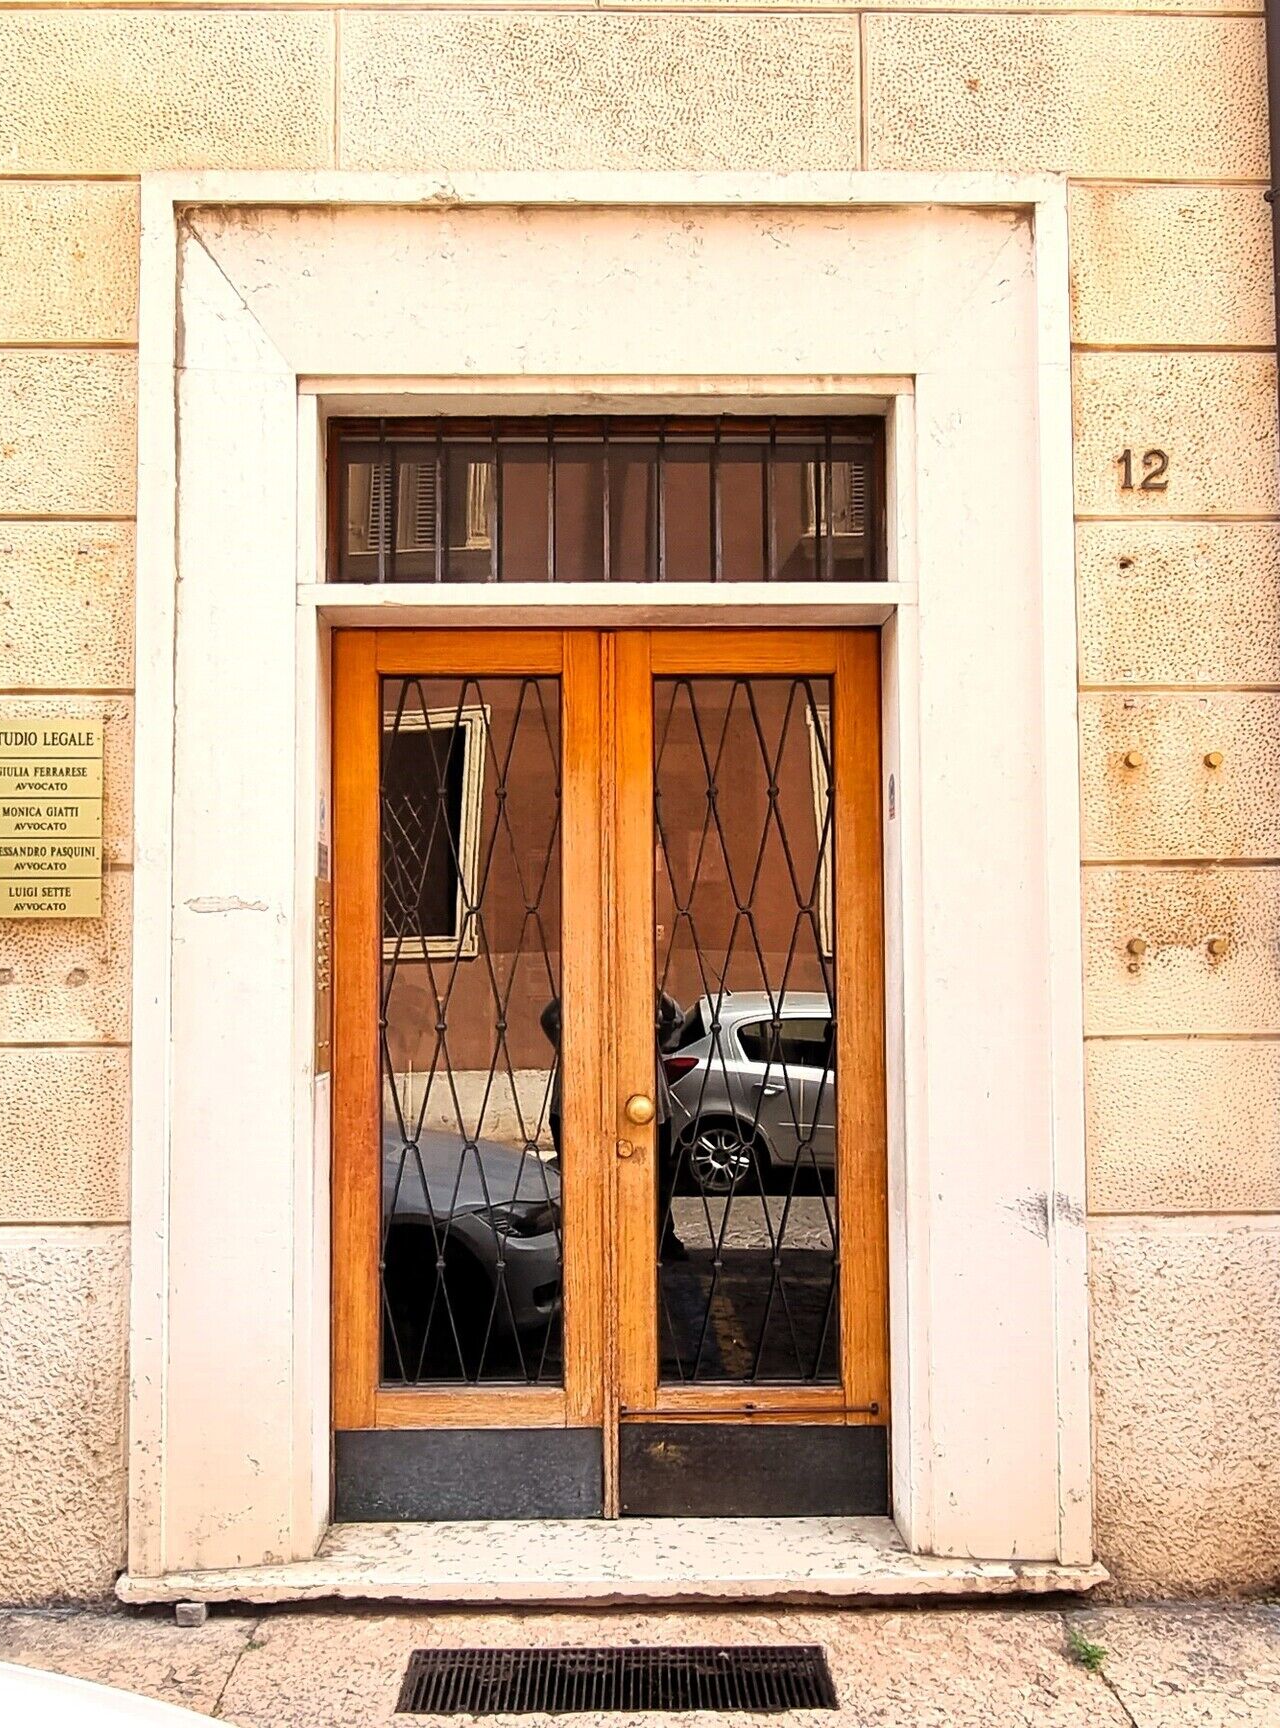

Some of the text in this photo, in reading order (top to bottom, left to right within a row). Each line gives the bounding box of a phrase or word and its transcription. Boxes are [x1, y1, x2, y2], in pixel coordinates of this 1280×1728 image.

[1116, 448, 1169, 490] 12
[43, 732, 95, 747] LEGALE
[33, 767, 88, 778] FERRARESE
[15, 782, 68, 792] AVVOCATO
[2, 806, 79, 817] MONICA GIATTI
[14, 822, 67, 831] AVVOCATO
[50, 846, 96, 859] PASQUINI
[14, 862, 67, 871] AVVOCATO
[8, 887, 72, 898] LUIGI SETTE
[13, 903, 67, 912] AVVOCATO
